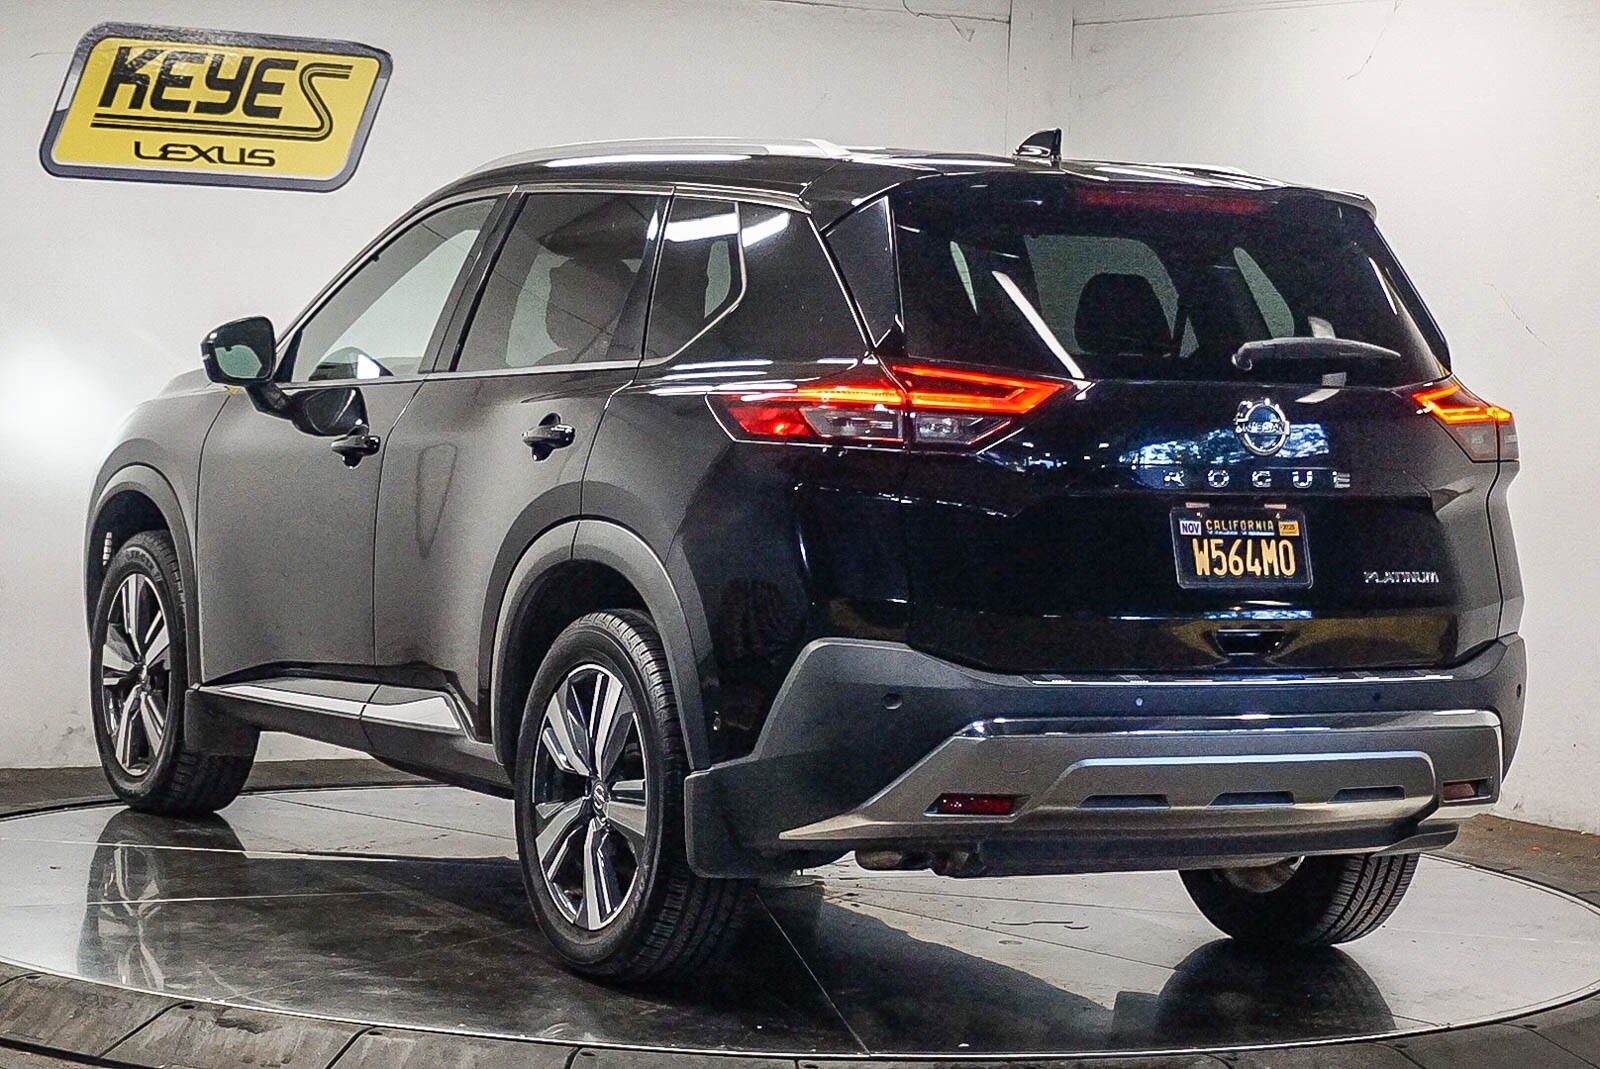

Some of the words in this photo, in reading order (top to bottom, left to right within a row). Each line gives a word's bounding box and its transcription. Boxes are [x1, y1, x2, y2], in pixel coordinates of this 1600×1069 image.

[91, 47, 353, 142] KEYES
[134, 140, 276, 167] LEXUS
[1163, 469, 1351, 488] ROGUE
[1181, 522, 1200, 534] NOV
[1205, 519, 1275, 531] CALIFORNIA
[1363, 571, 1440, 583] PLATINUM
